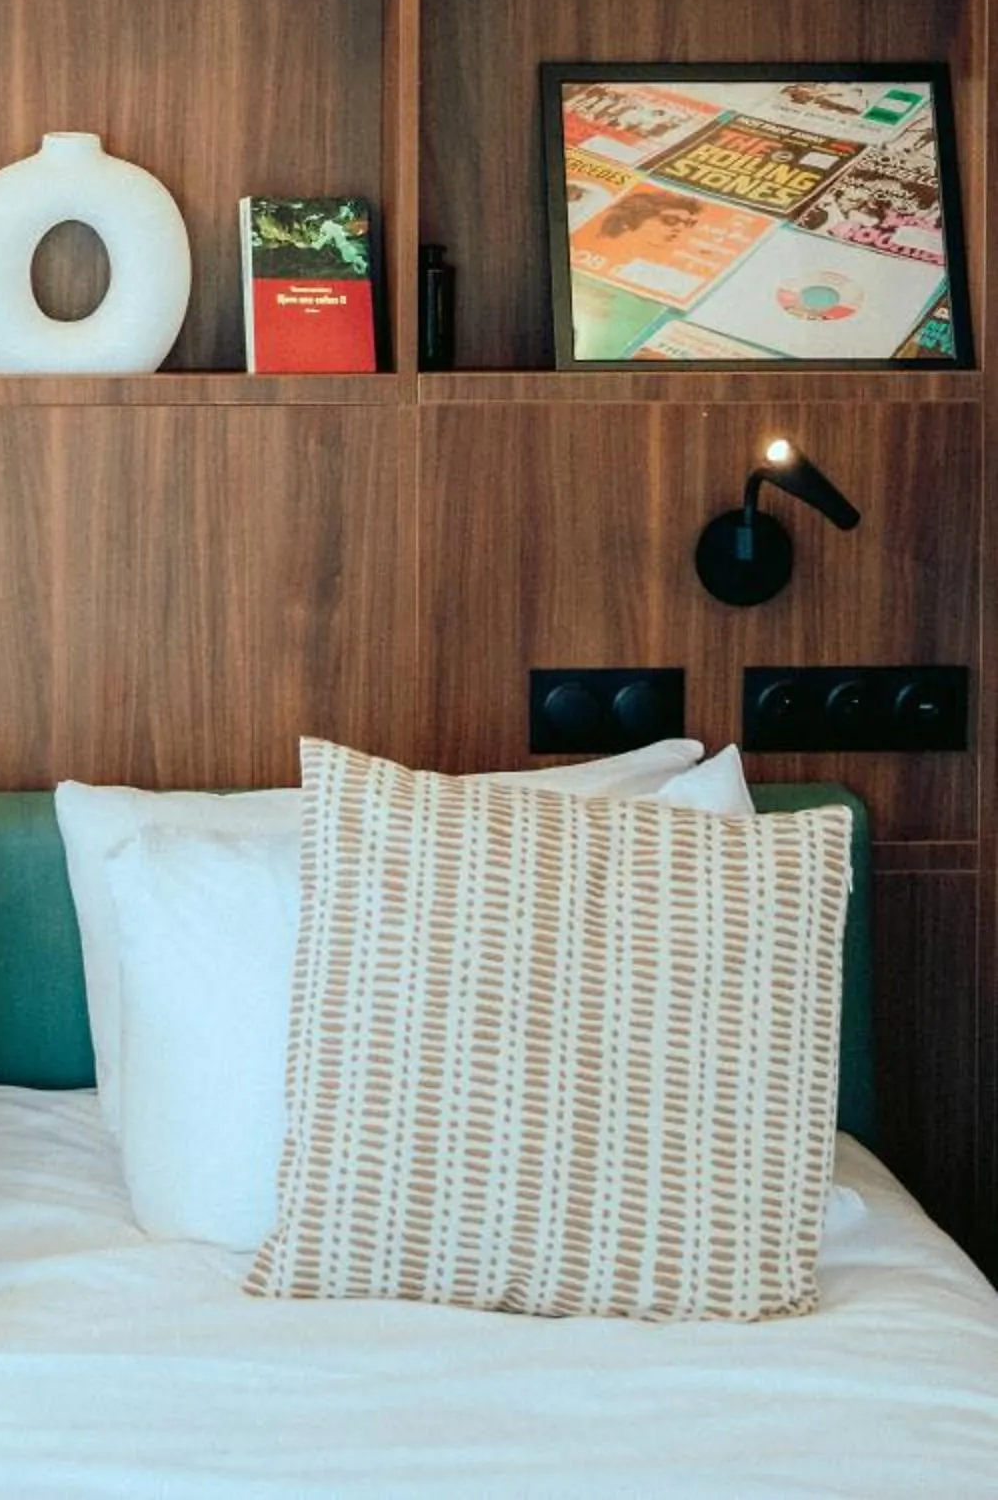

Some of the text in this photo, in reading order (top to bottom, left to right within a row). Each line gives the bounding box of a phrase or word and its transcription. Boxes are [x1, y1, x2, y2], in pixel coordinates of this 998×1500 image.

[720, 129, 784, 158] THE
[665, 159, 808, 208] STONES
[685, 144, 823, 192] ROLLING
